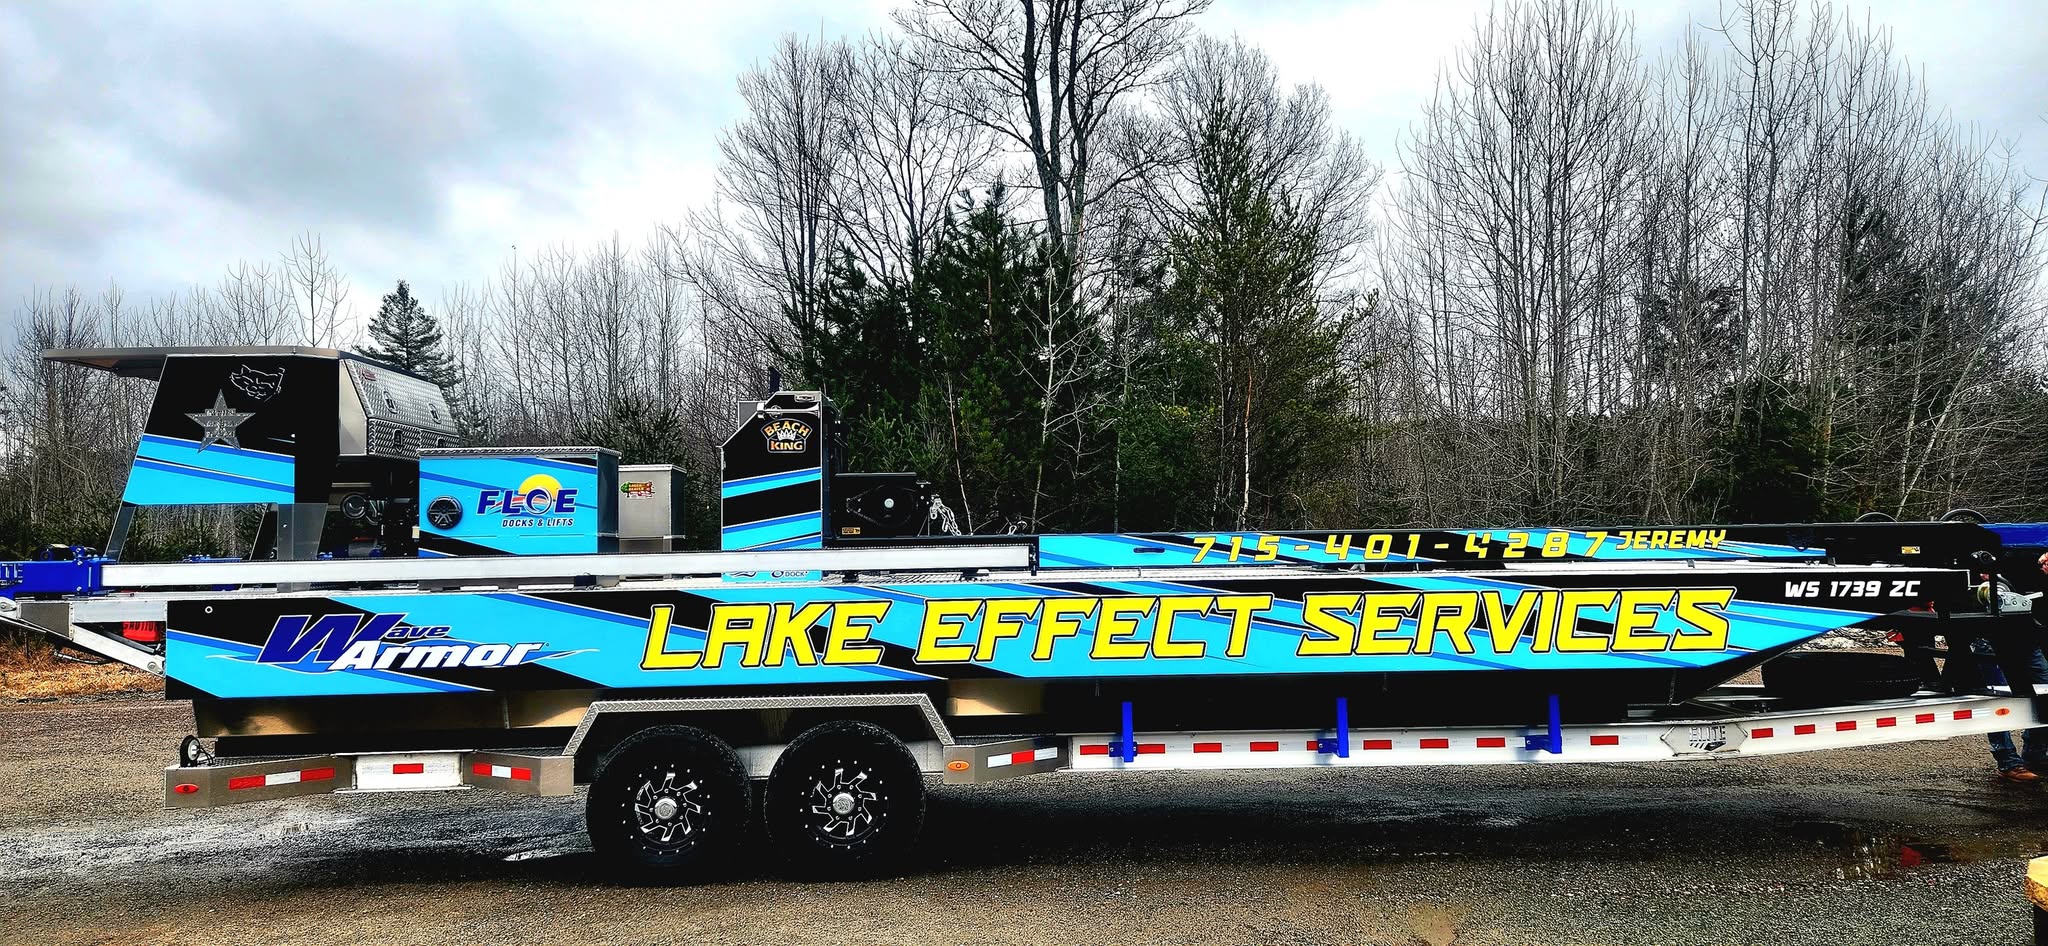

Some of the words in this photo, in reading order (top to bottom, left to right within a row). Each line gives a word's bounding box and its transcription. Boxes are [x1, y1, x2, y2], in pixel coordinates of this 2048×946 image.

[764, 420, 810, 437] BEACH
[770, 440, 803, 451] KING
[477, 487, 578, 515] FLOE
[502, 518, 534, 528] DOCKS
[537, 518, 544, 527] &
[547, 518, 574, 527] LIFTS
[1616, 530, 1727, 550] JEREMY
[1785, 581, 1820, 598] WS
[1830, 580, 1881, 597] 1739
[1889, 580, 1921, 597] ZC
[641, 600, 893, 669] LAKE
[914, 593, 1274, 664] EFFECT
[1296, 587, 1737, 656] SERVICES
[257, 613, 451, 664] Wave
[327, 640, 545, 670] Armor
